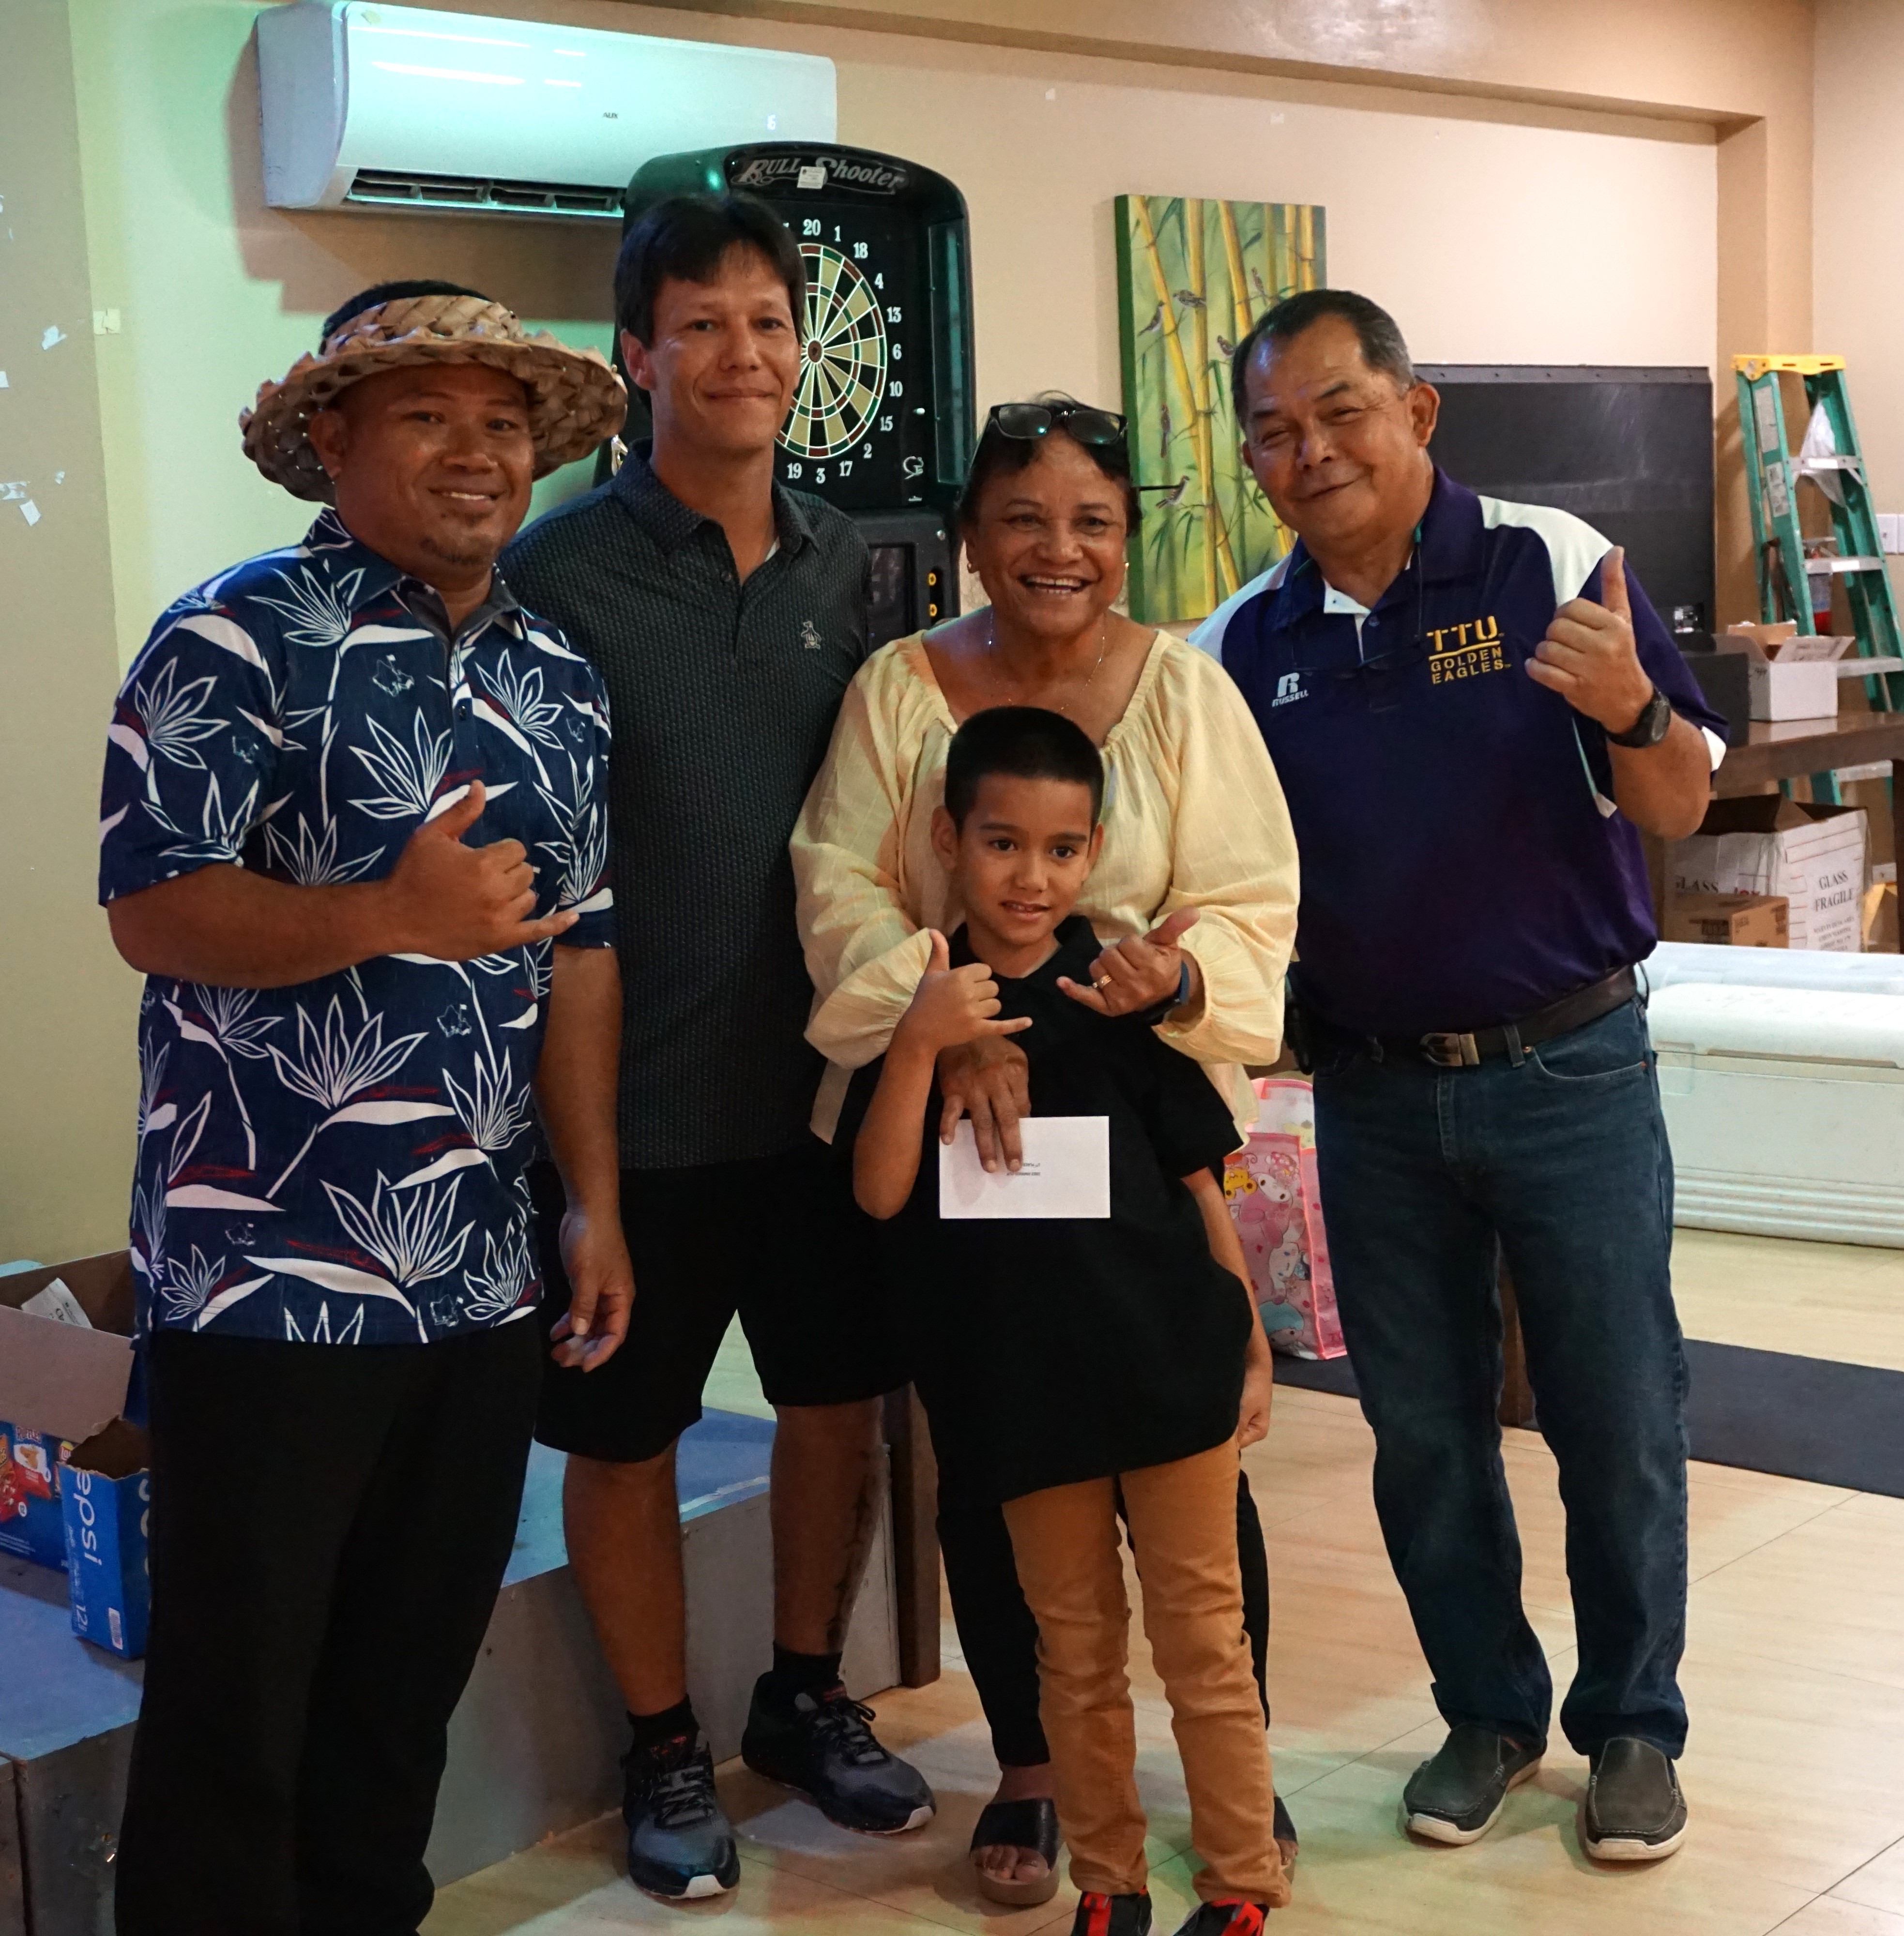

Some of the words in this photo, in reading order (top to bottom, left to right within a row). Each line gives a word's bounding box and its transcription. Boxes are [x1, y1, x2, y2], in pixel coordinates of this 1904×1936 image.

[735, 157, 802, 186] BULL
[803, 219, 821, 236] 20
[834, 225, 841, 242] 1
[853, 242, 868, 259] 18
[874, 272, 884, 289] 4
[886, 306, 902, 323] 13
[892, 343, 902, 360] 6
[889, 380, 903, 397] 10
[880, 415, 893, 432] 15
[863, 443, 872, 459] 2
[787, 462, 802, 479] 19
[816, 468, 826, 484] 3
[839, 460, 853, 477] 17
[1427, 616, 1498, 652] TTU
[1431, 647, 1502, 673] GOLDEN
[1432, 659, 1504, 684] EAGLES
[1272, 690, 1309, 707] RUSSELL
[1819, 870, 1849, 891] GLASS
[1814, 888, 1855, 912] FRAGILE
[73, 1471, 102, 1565] epsi
